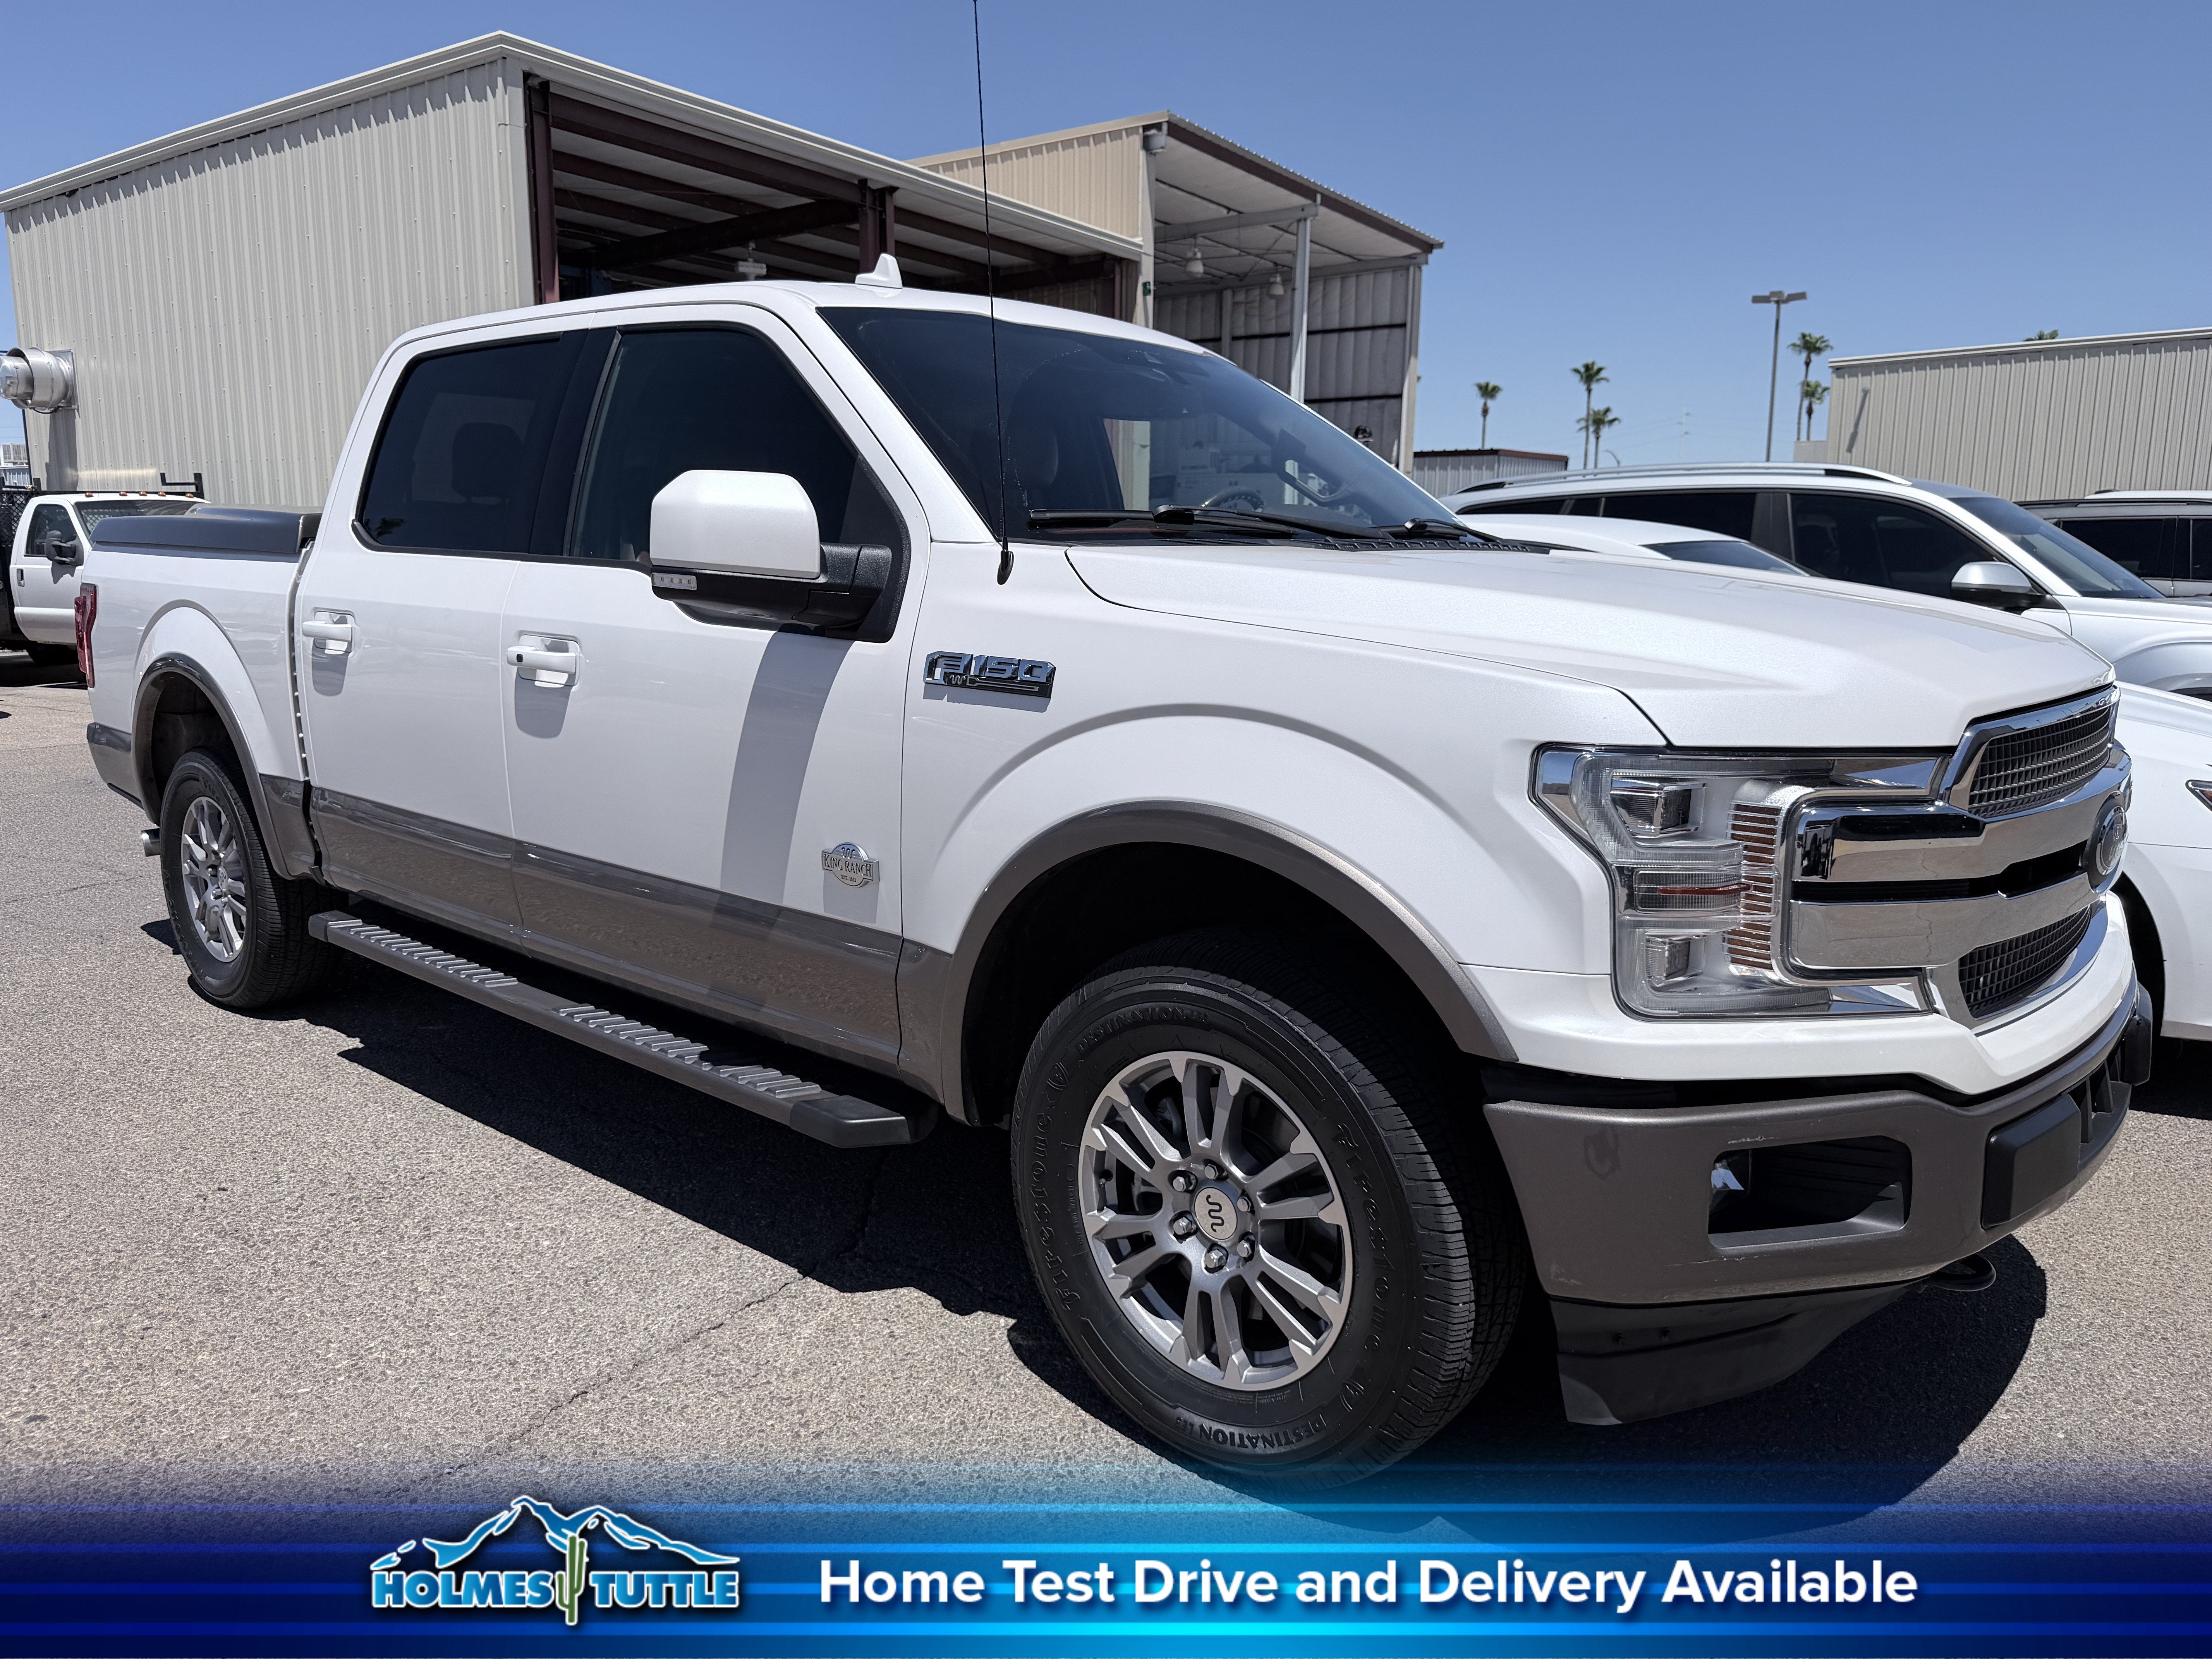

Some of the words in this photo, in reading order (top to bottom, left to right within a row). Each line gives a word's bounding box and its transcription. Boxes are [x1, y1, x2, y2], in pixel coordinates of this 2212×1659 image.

[823, 854, 843, 871] KING
[844, 860, 872, 878] RANCH
[1075, 1006, 1187, 1054] DESTINATION
[1199, 1414, 1328, 1449] DESTINATION
